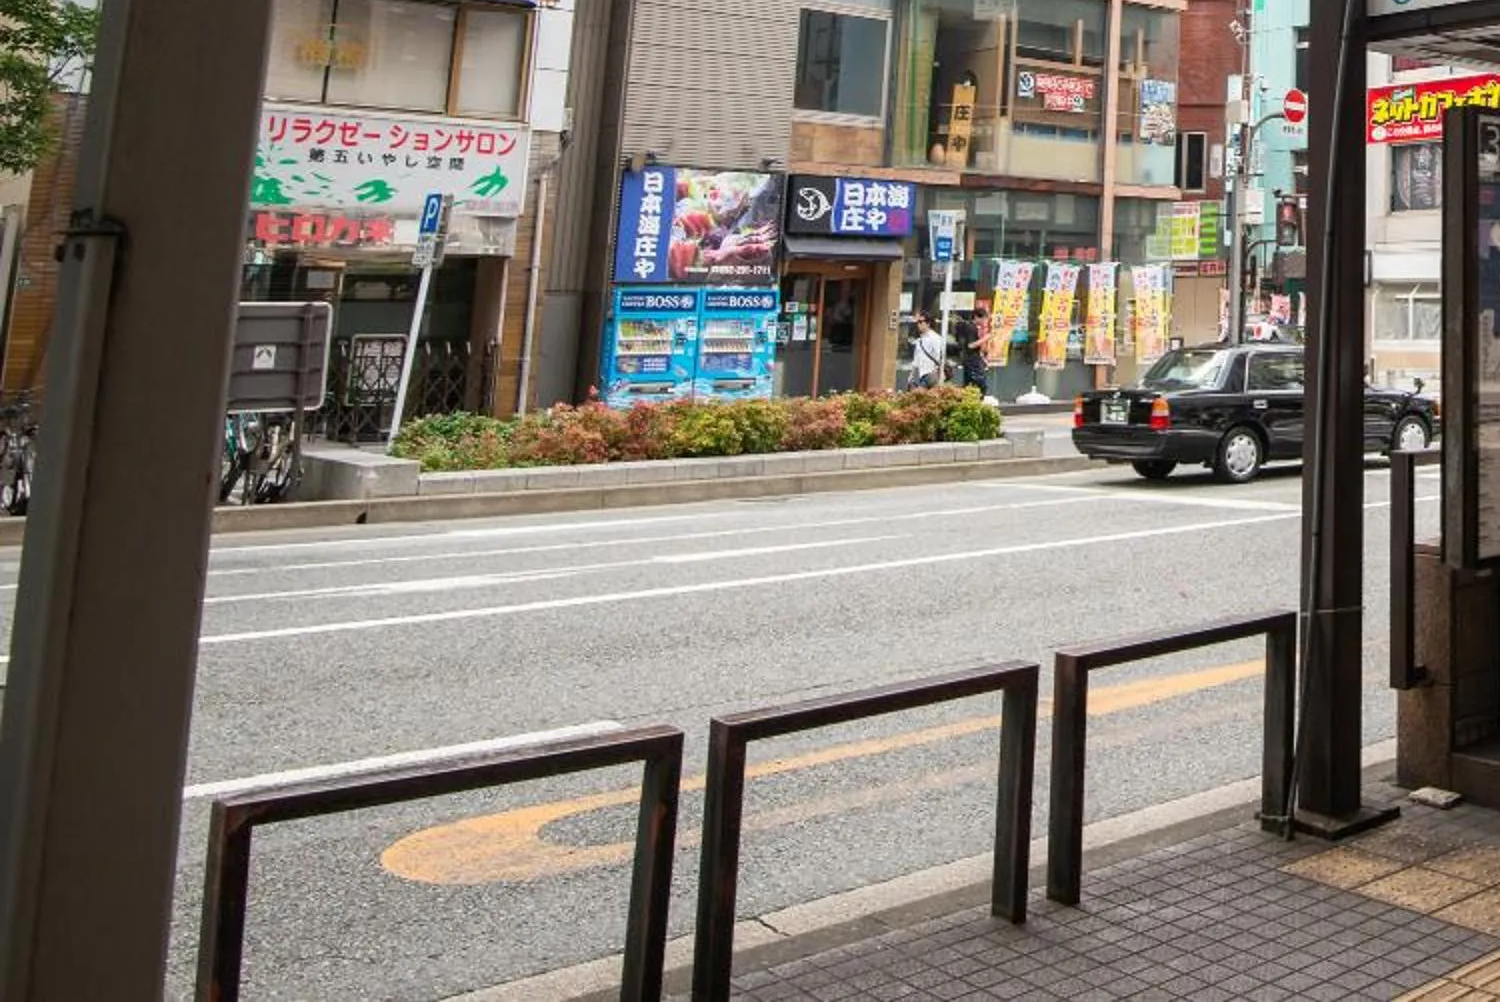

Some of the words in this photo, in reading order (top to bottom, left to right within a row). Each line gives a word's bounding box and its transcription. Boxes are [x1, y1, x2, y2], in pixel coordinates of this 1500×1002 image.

[267, 115, 518, 156] リラクゼーションサロン
[951, 104, 970, 152] 庄や
[1486, 126, 1500, 153] 3
[308, 147, 466, 171] 第五いやし空間
[843, 182, 910, 209] 日本海
[633, 171, 665, 279] 日本海庄や
[840, 208, 887, 231] 庄や
[645, 294, 679, 309] BOSS
[728, 294, 761, 309] BOSS
